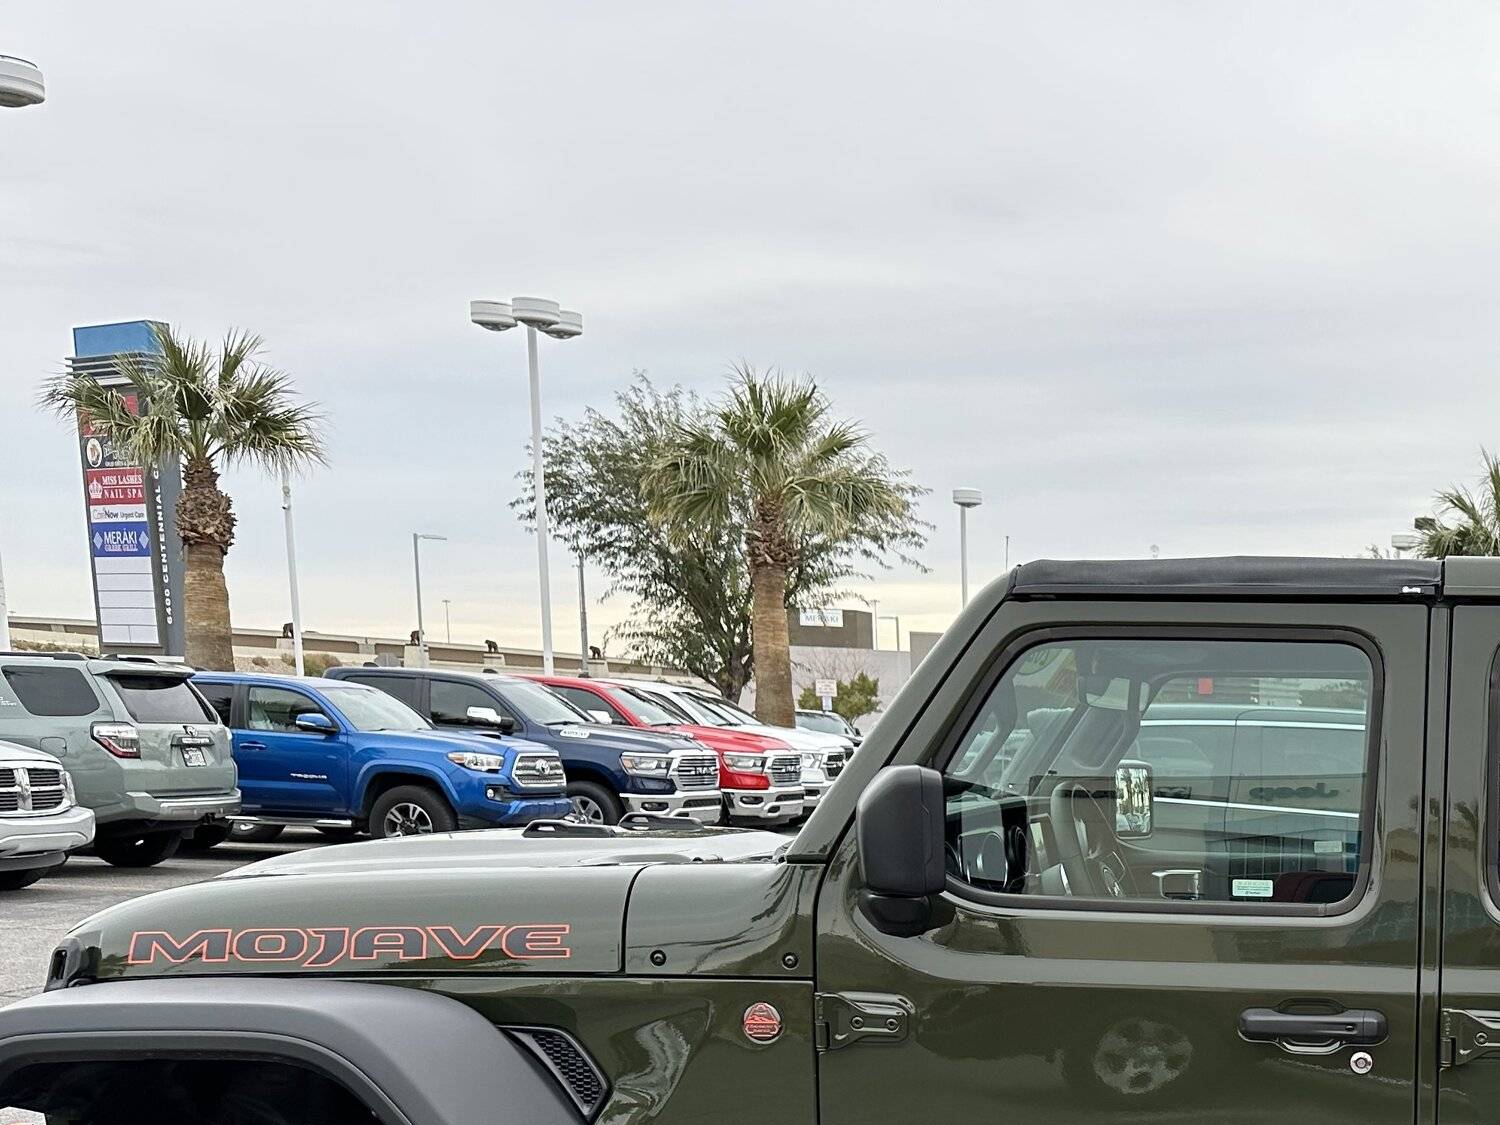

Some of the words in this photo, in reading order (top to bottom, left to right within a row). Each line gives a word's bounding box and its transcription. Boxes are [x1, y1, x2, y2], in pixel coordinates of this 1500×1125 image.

[102, 475, 117, 485] MISS
[104, 488, 124, 499] NAIL
[127, 488, 143, 498] SPA
[155, 485, 169, 583] CENTENNIAL
[164, 588, 173, 625] 6400
[128, 924, 570, 967] MOJAVE
